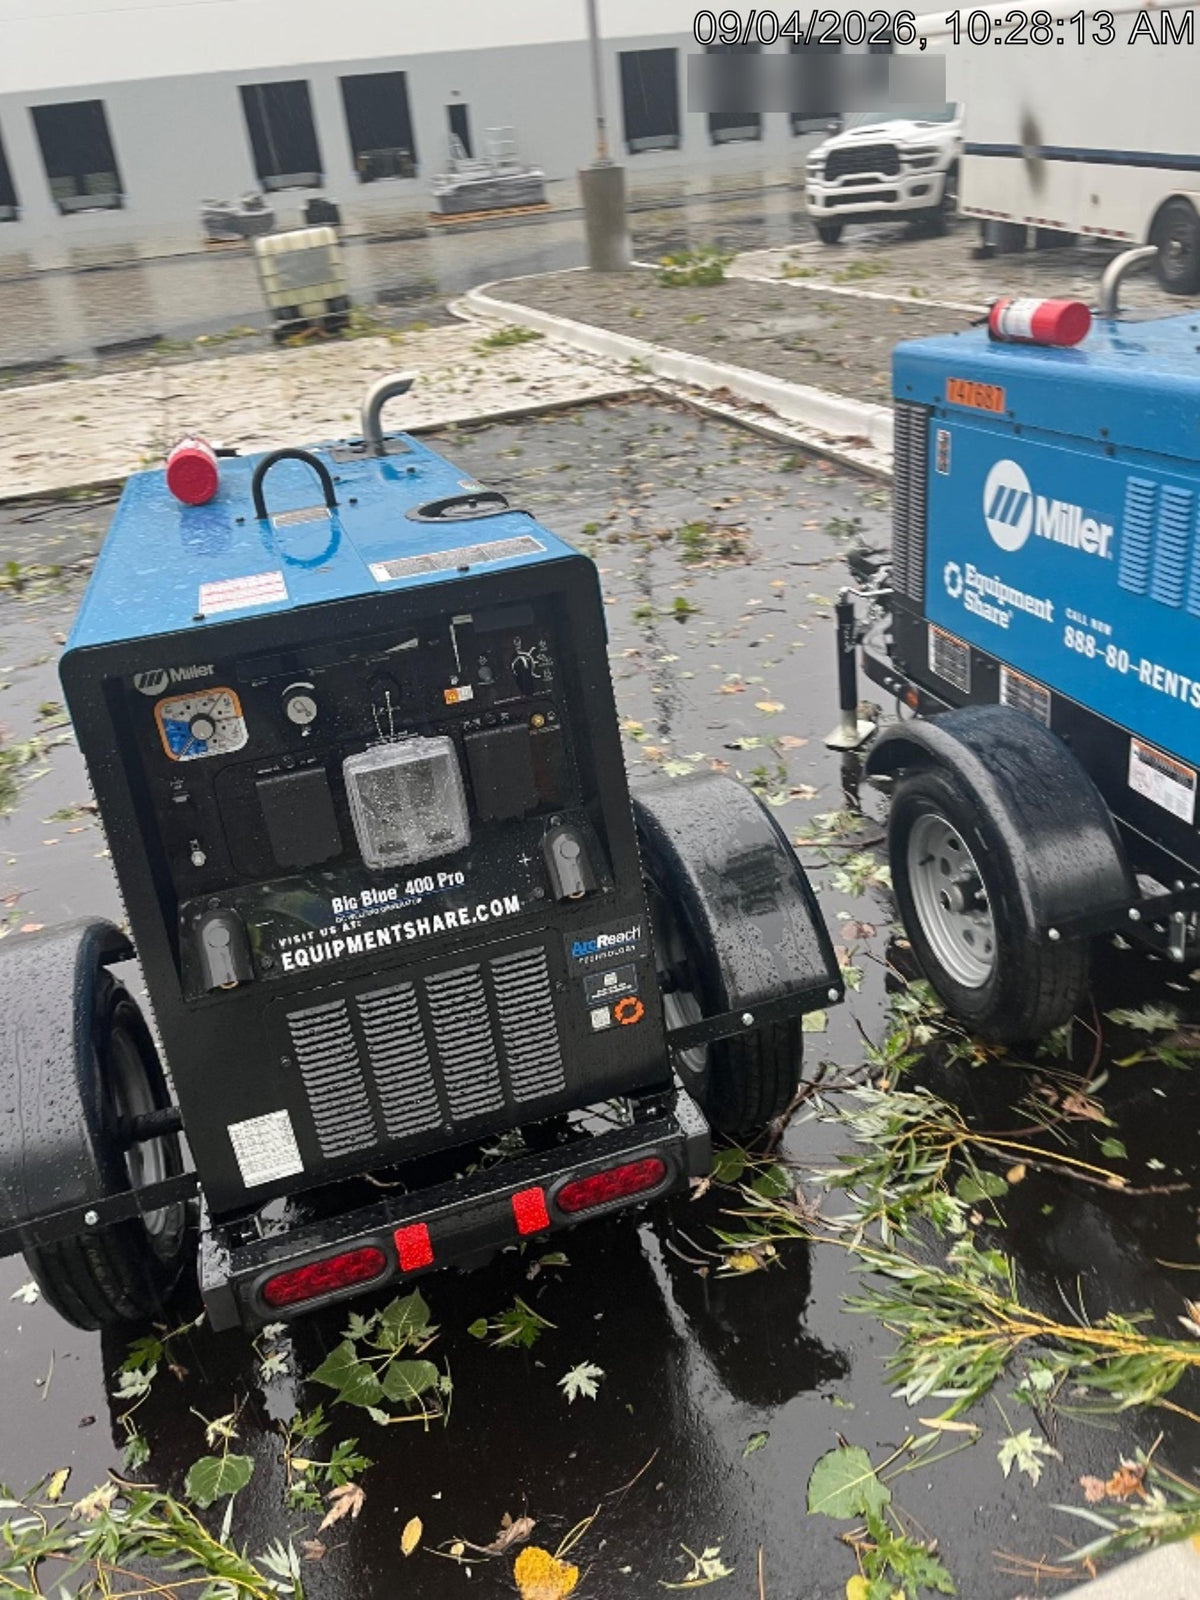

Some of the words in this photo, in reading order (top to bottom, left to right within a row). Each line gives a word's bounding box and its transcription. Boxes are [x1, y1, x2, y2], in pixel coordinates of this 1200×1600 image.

[1034, 495, 1114, 559] Miller
[963, 588, 1010, 629] Share
[965, 562, 1054, 623] Equipment
[169, 664, 215, 682] Miller
[1063, 624, 1200, 709] 888-80-RENTS
[331, 895, 359, 915] Big
[360, 887, 398, 908] Blue
[404, 875, 434, 896] 400
[437, 871, 465, 888] Pro
[278, 930, 314, 947] VISIT
[320, 925, 338, 938] US
[281, 895, 520, 971] EQUIPMENTSHARE.COM
